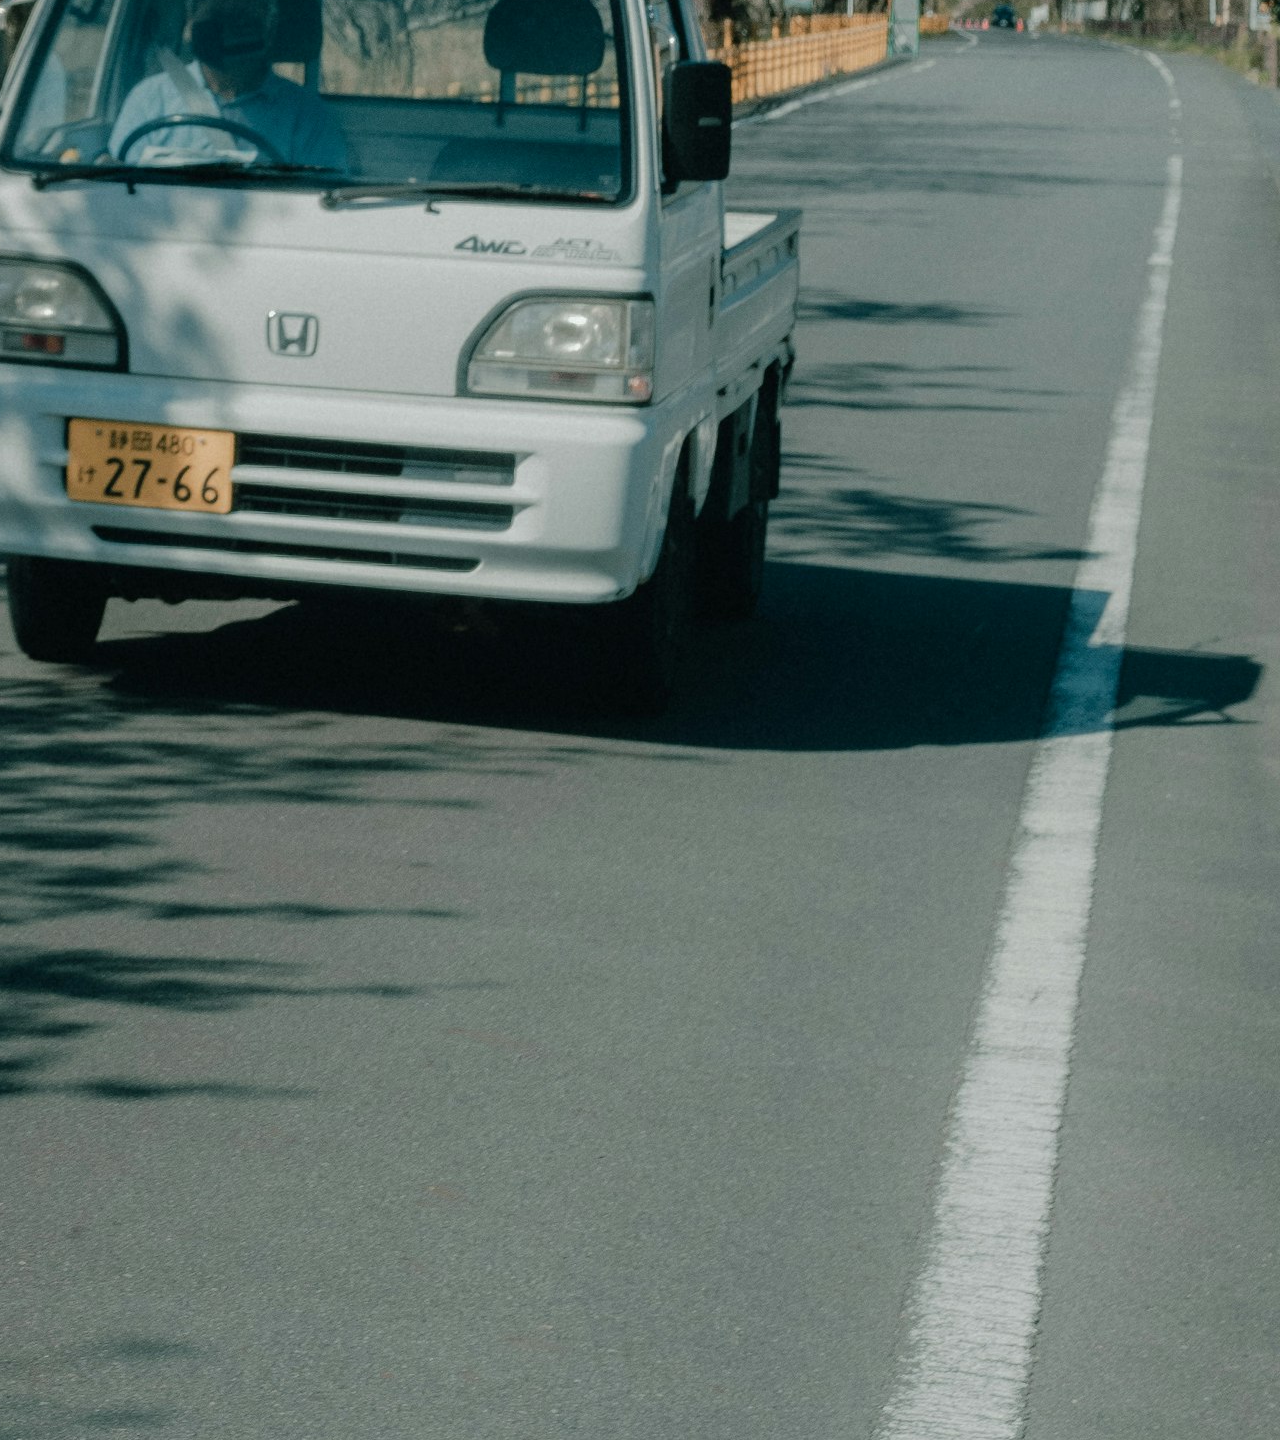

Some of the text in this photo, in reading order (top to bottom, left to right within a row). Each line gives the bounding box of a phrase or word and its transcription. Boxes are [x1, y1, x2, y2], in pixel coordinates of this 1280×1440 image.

[454, 234, 527, 255] 4WD
[156, 434, 194, 455] 480
[104, 457, 219, 504] 27-66
